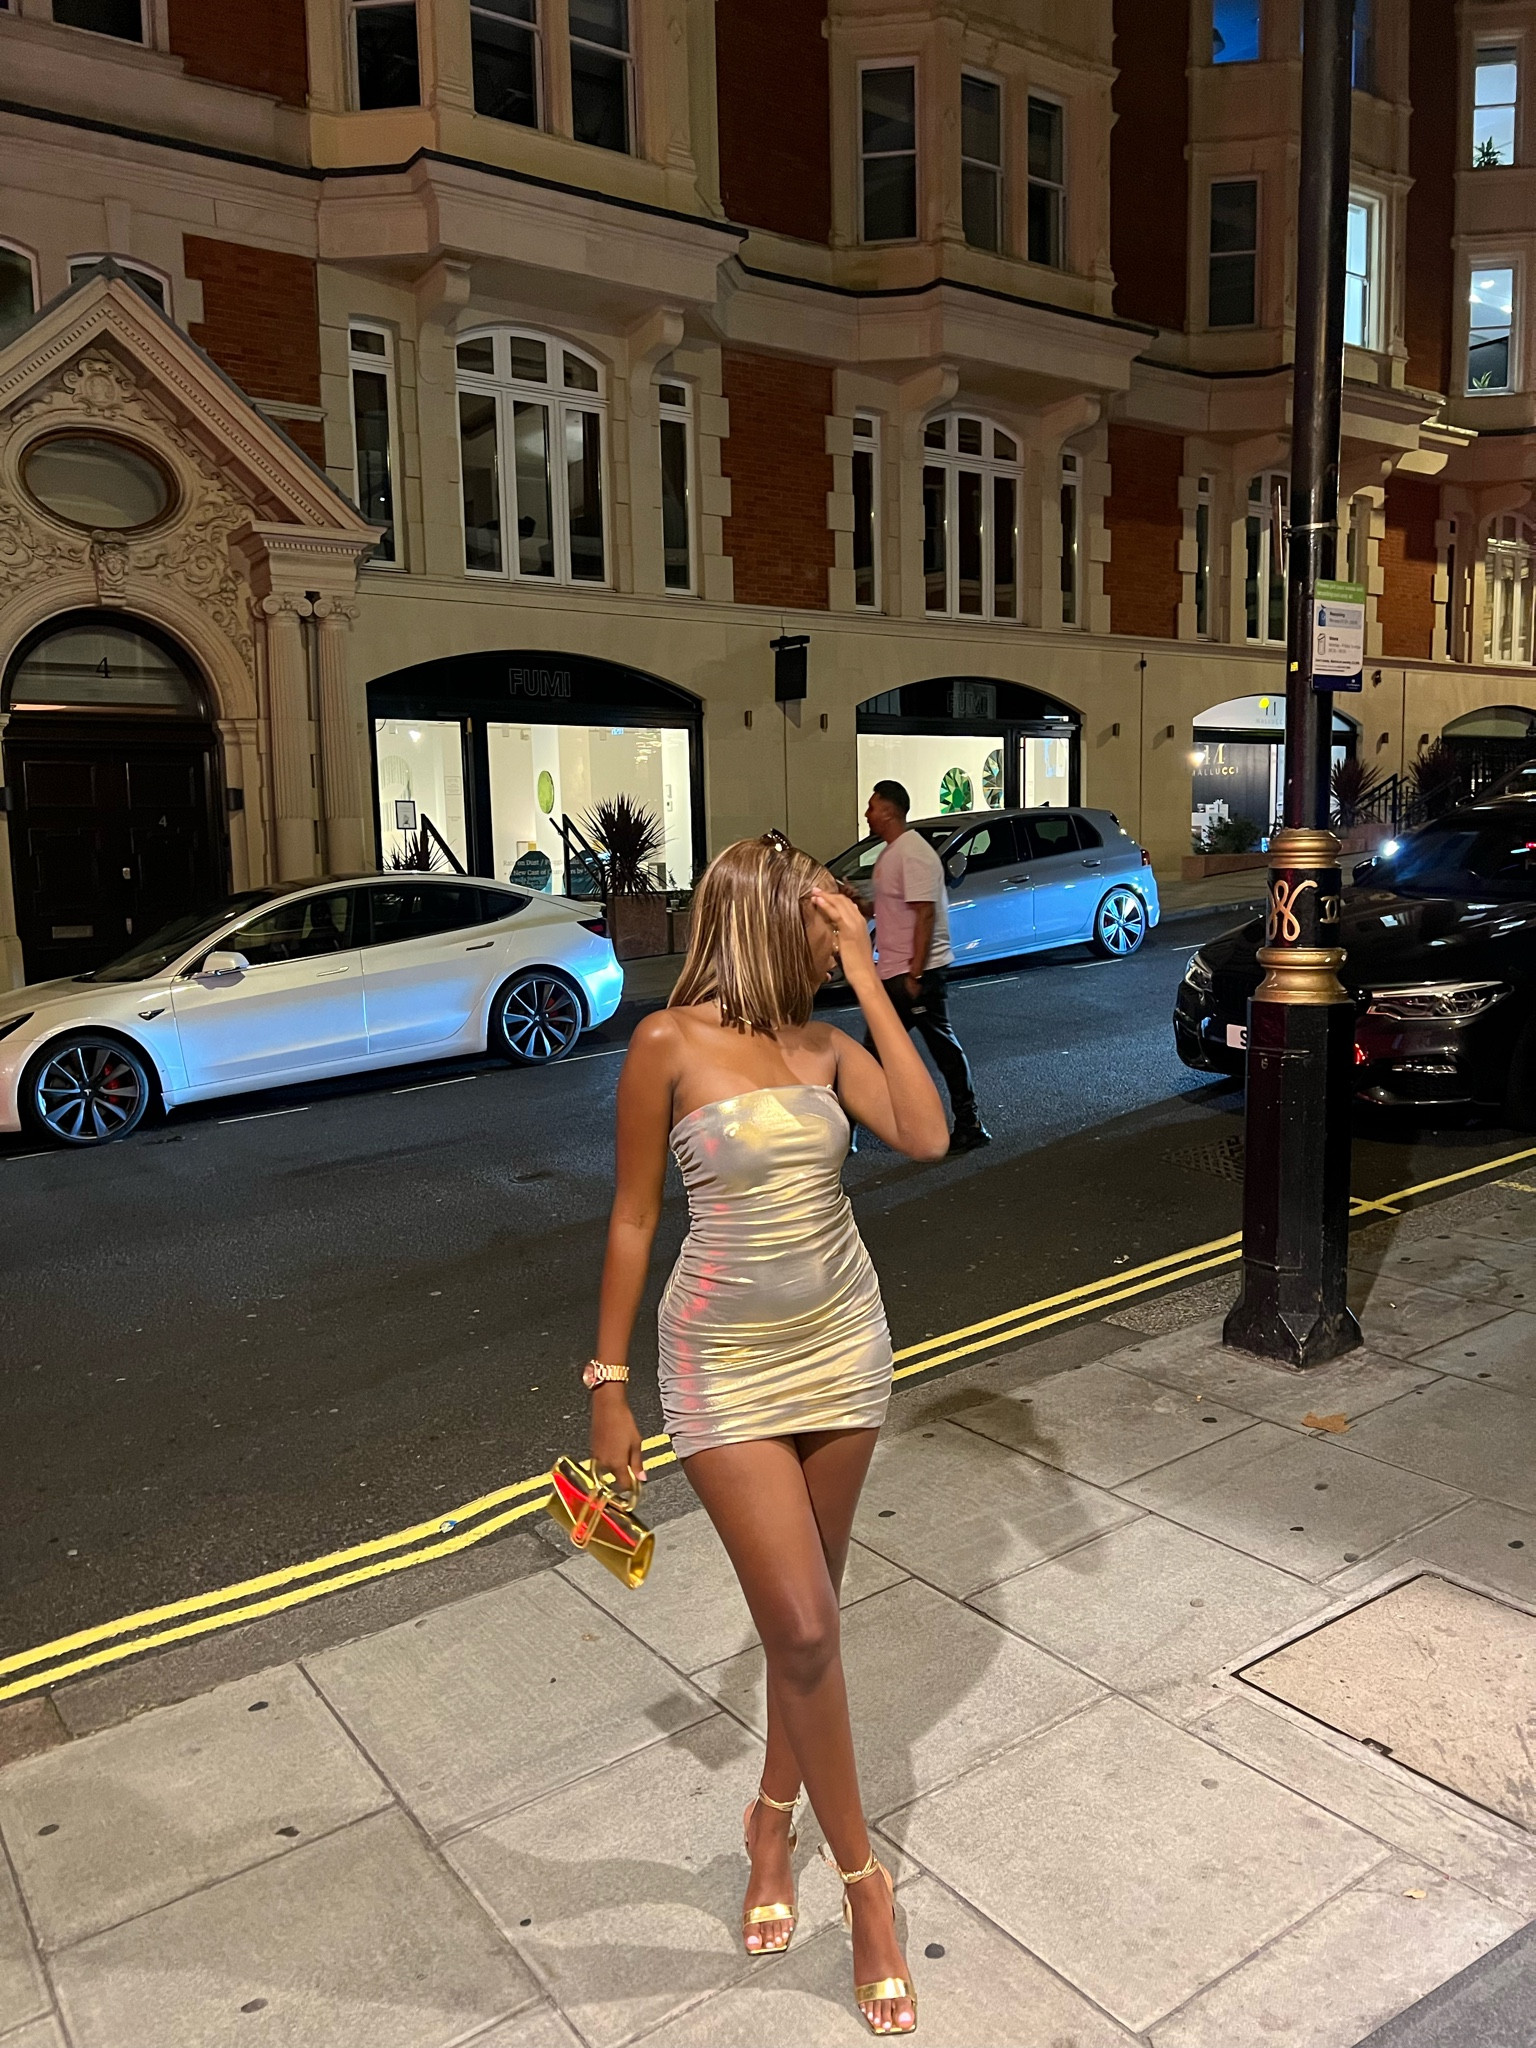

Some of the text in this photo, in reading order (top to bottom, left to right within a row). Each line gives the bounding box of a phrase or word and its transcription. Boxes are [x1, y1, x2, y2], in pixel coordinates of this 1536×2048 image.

[96, 656, 112, 679] 4
[509, 668, 571, 698] FUMI
[158, 815, 168, 828] 4
